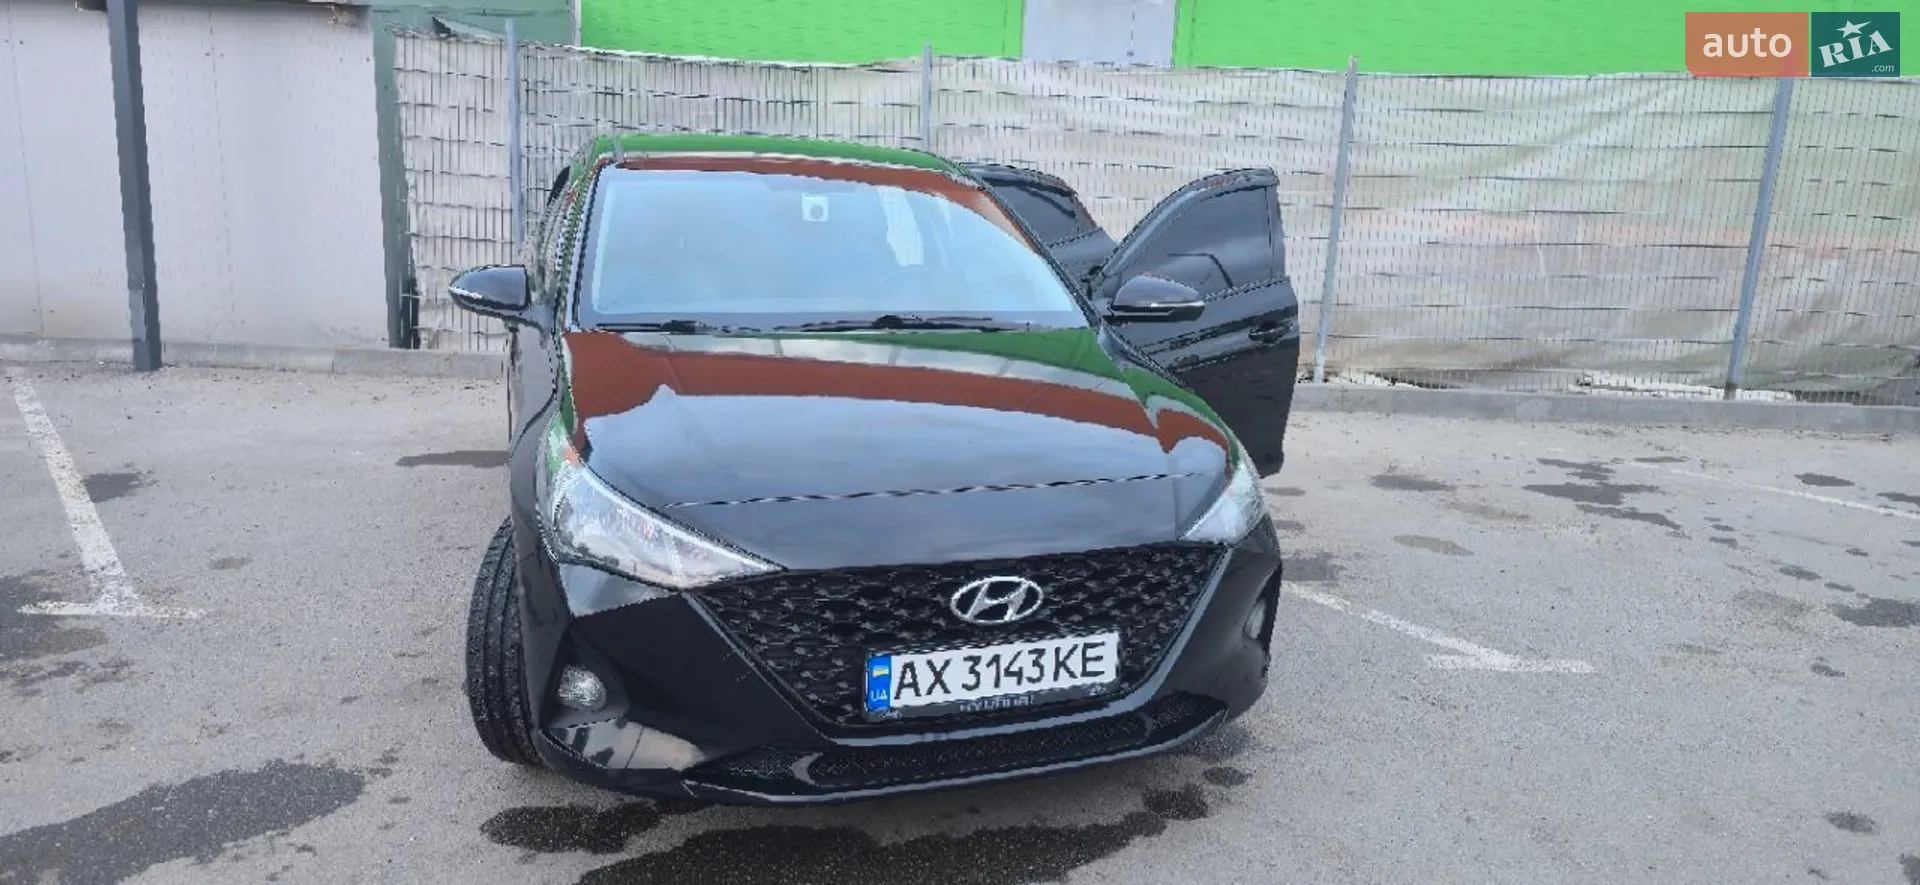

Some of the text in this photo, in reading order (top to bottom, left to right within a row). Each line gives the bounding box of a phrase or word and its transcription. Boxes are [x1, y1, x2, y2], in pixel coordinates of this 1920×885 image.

[894, 641, 1106, 700] AX 3143 KE
[870, 690, 888, 702] UA
